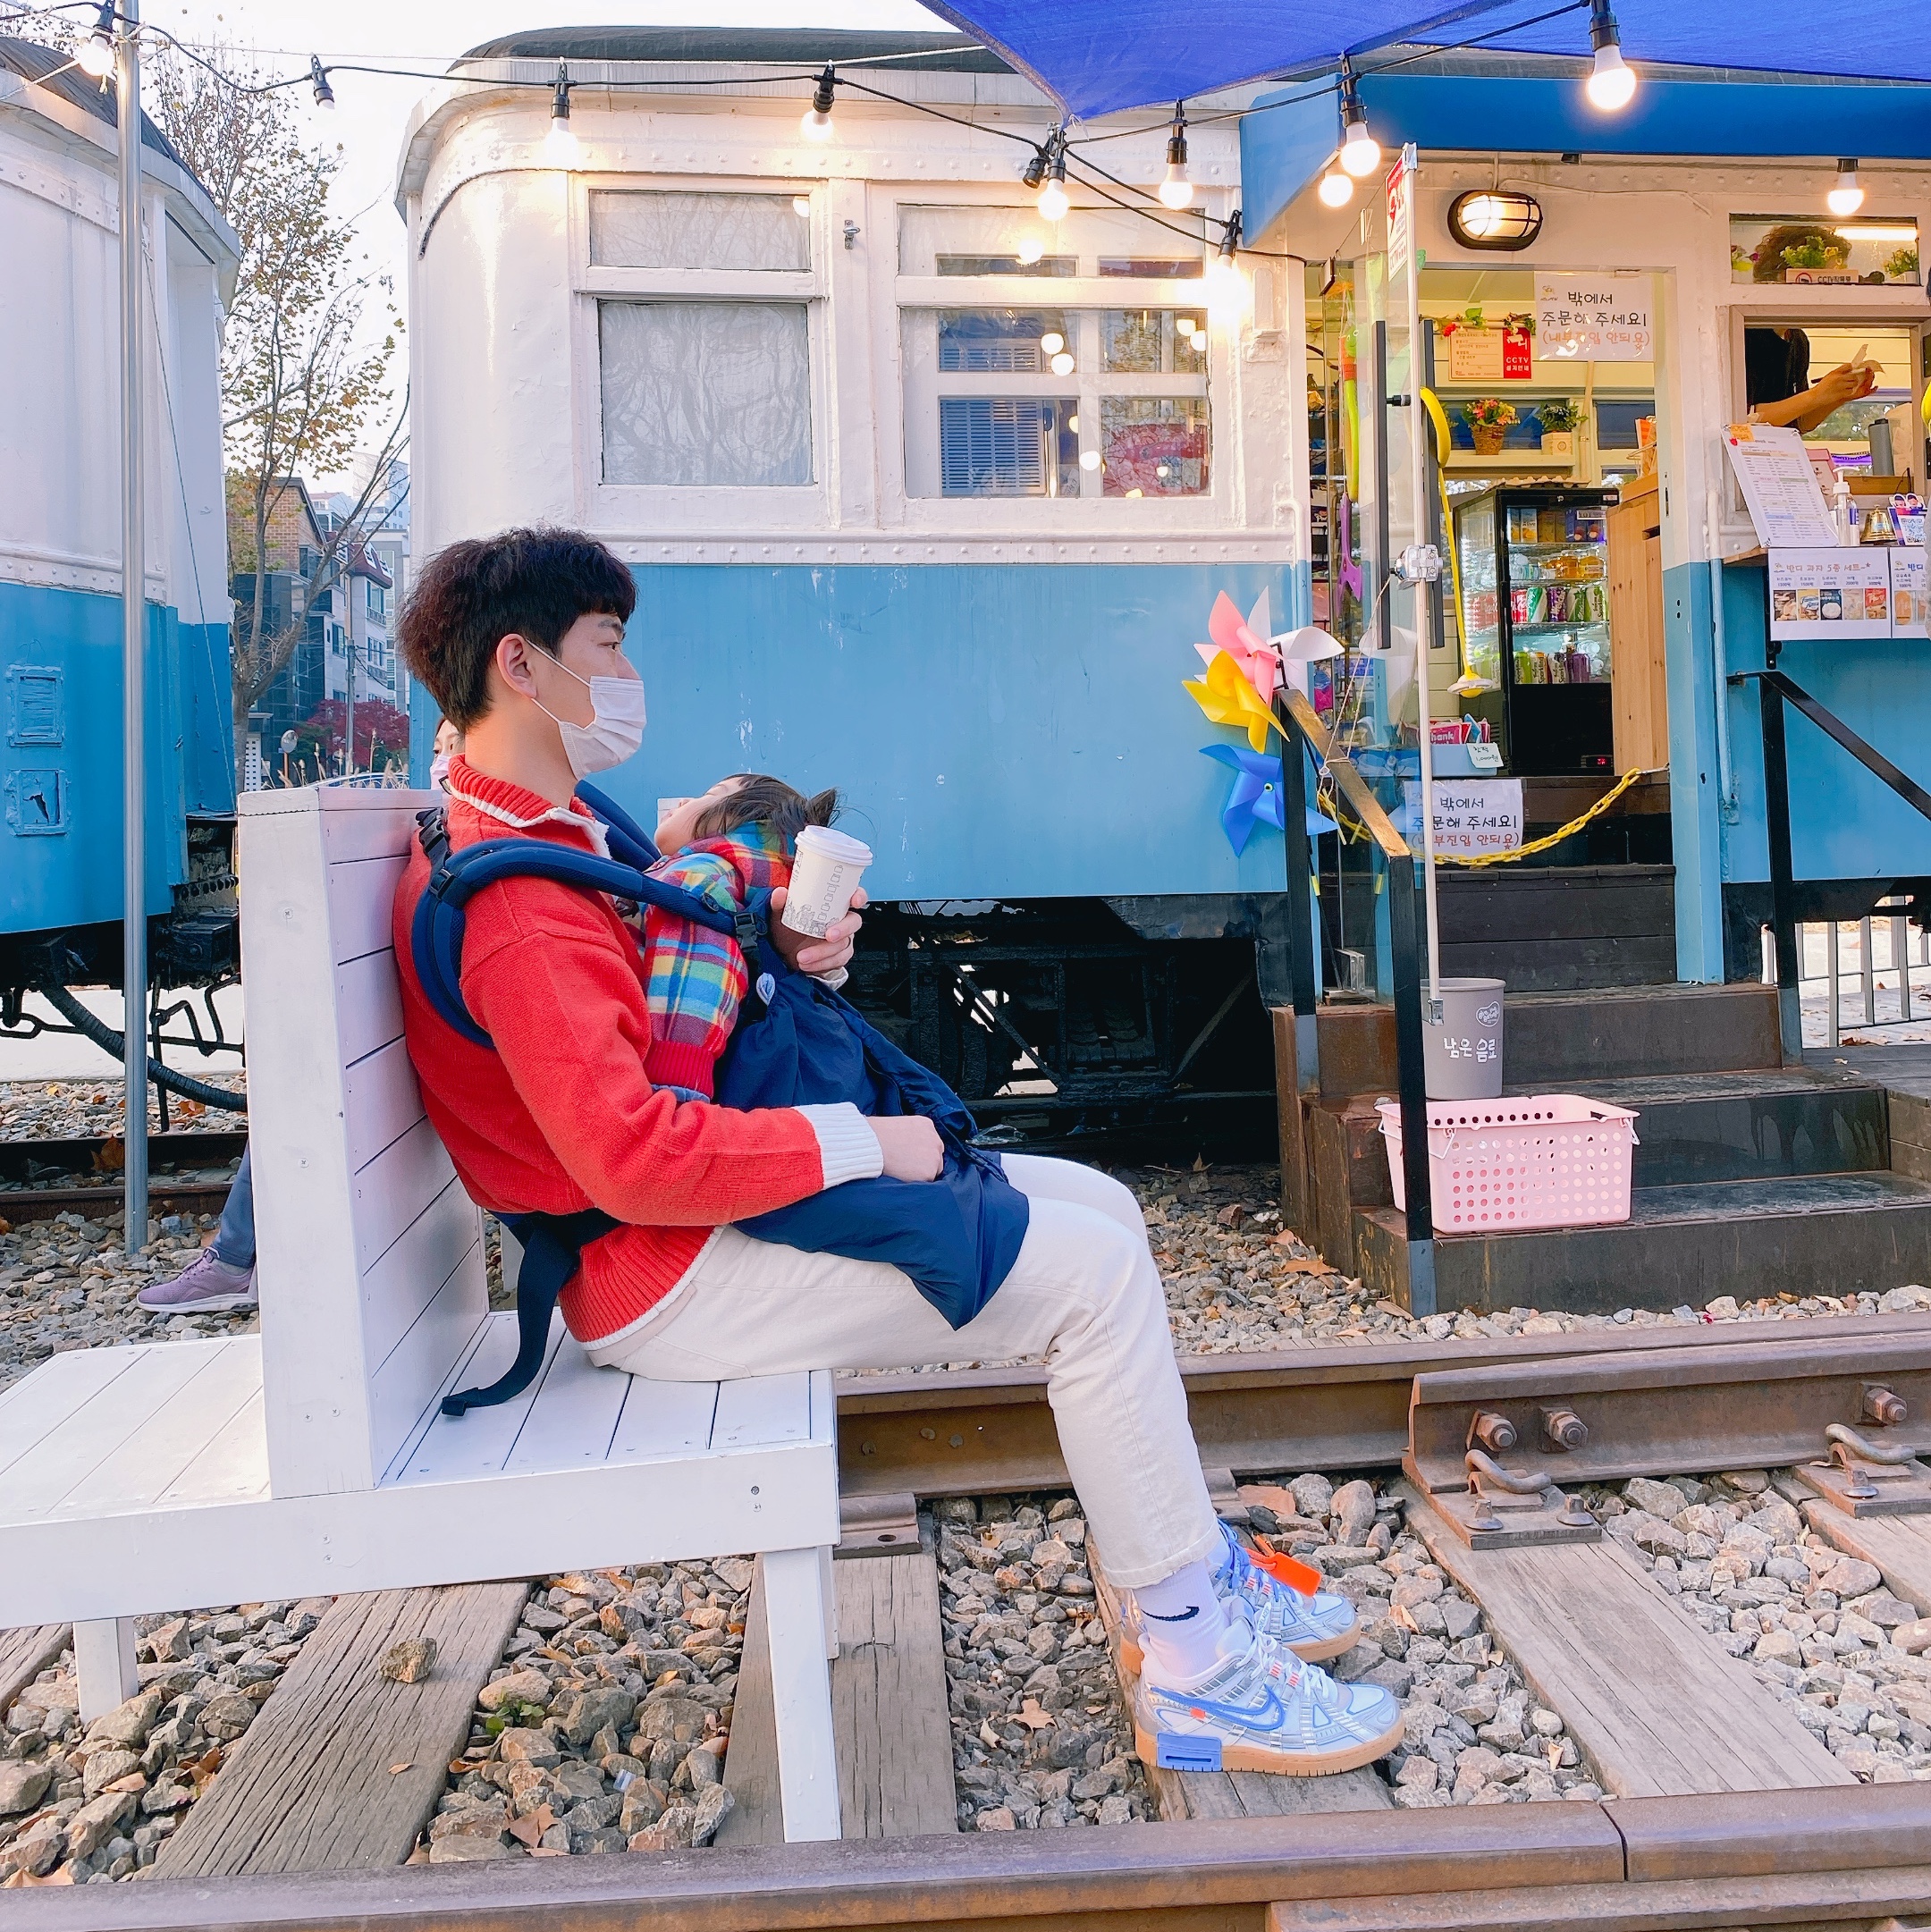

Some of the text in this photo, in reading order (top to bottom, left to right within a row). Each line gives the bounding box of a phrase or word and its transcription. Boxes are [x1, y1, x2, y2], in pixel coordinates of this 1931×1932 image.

[1568, 291, 1613, 307] 밖에서
[1541, 310, 1647, 327] 주문해 주세요!
[1807, 564, 1824, 572] 과자
[1827, 563, 1841, 573] 5종
[1430, 730, 1455, 742] hank
[1440, 797, 1484, 812] 밖에서
[1412, 814, 1517, 831] 주문해 주세요!
[1443, 1037, 1497, 1063] 남은 음료
